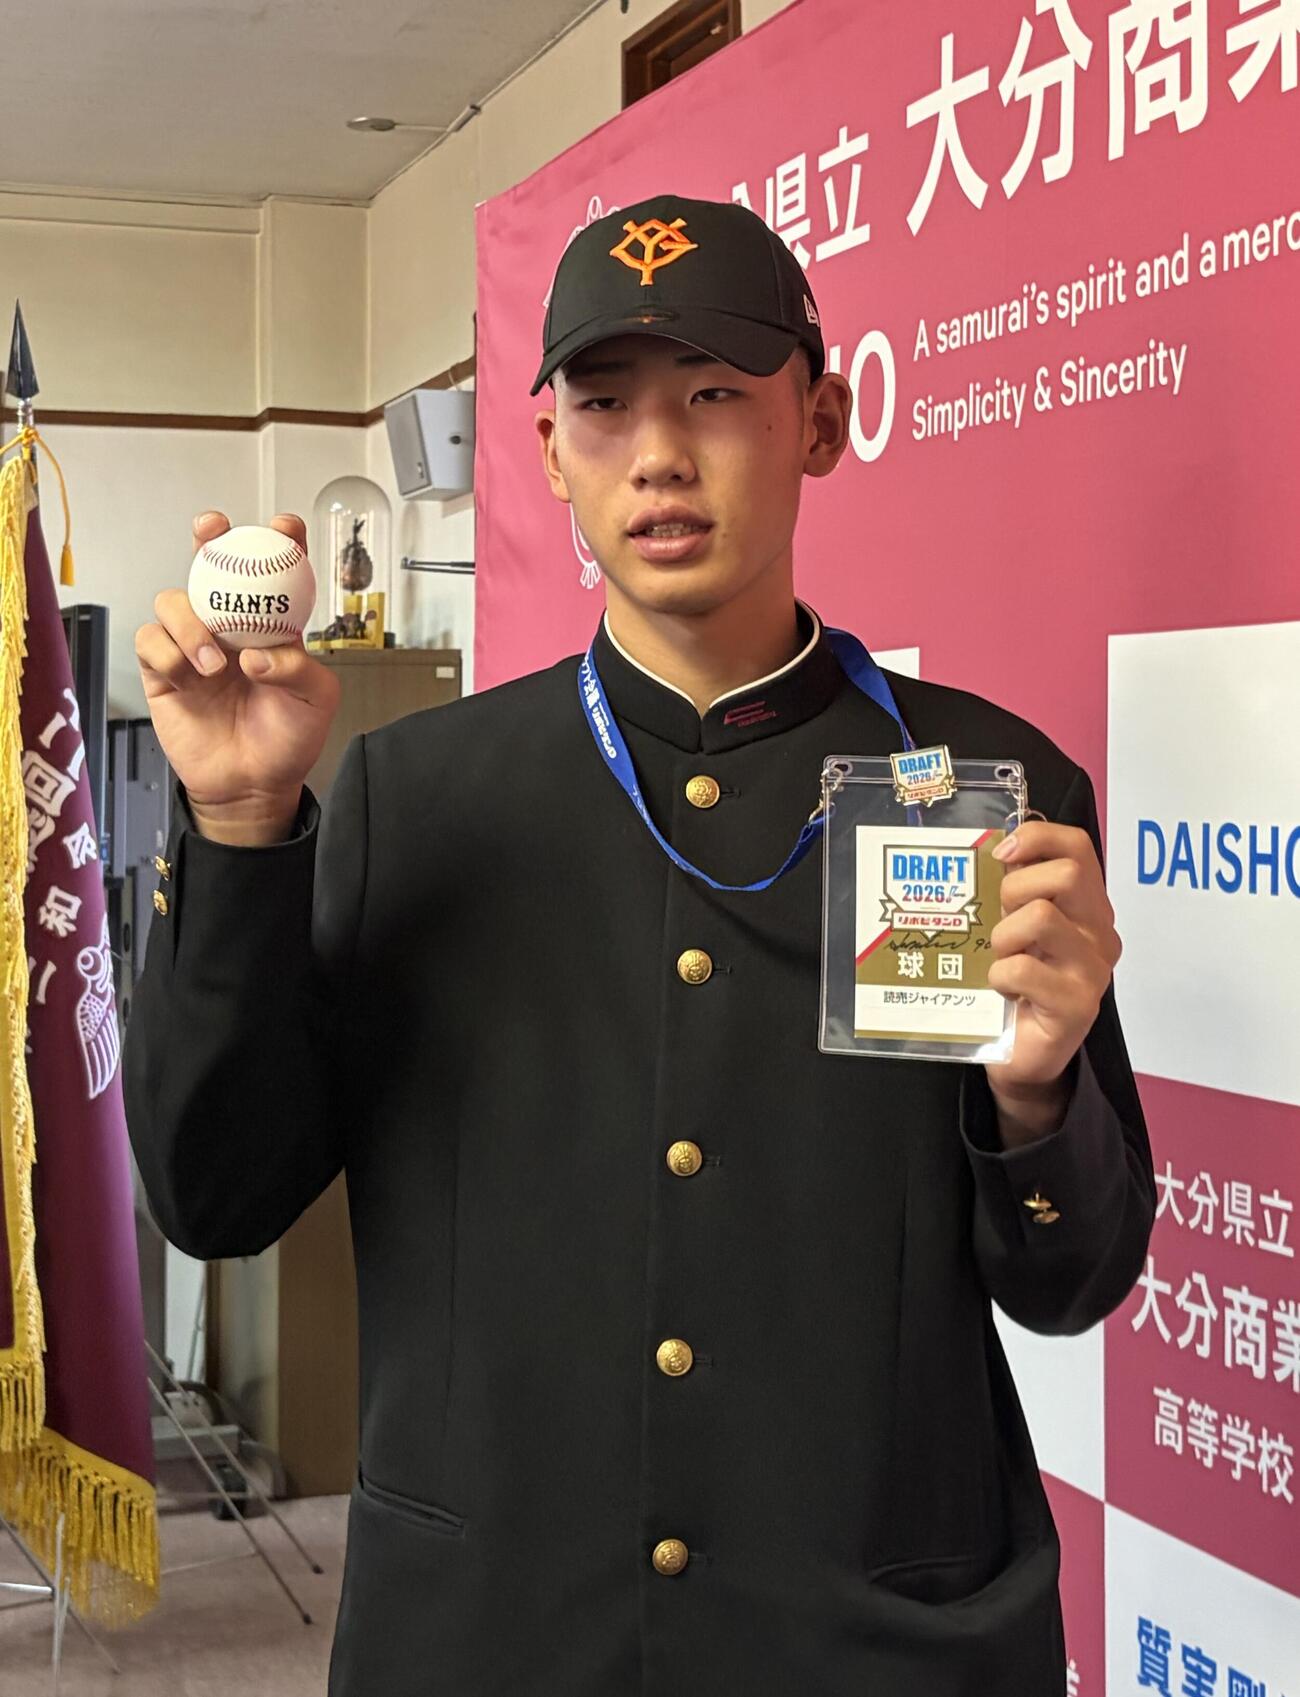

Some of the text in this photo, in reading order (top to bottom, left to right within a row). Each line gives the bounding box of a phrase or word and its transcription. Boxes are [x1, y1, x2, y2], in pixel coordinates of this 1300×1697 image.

[732, 125, 871, 271] 県立
[912, 318, 931, 363] A
[1056, 257, 1127, 328] spirit
[1135, 231, 1190, 298] and
[1199, 239, 1217, 278] a
[911, 338, 1188, 442] Simplicity & Sincerity
[208, 590, 290, 615] GIANTS
[898, 753, 941, 775] DRAFT
[893, 853, 968, 883] DRAFT
[902, 884, 945, 903] 2026
[883, 990, 976, 1007] 読売ジャイアンツ
[1154, 1160, 1295, 1259] 大分県立
[1152, 1386, 1295, 1505] 高等学校
